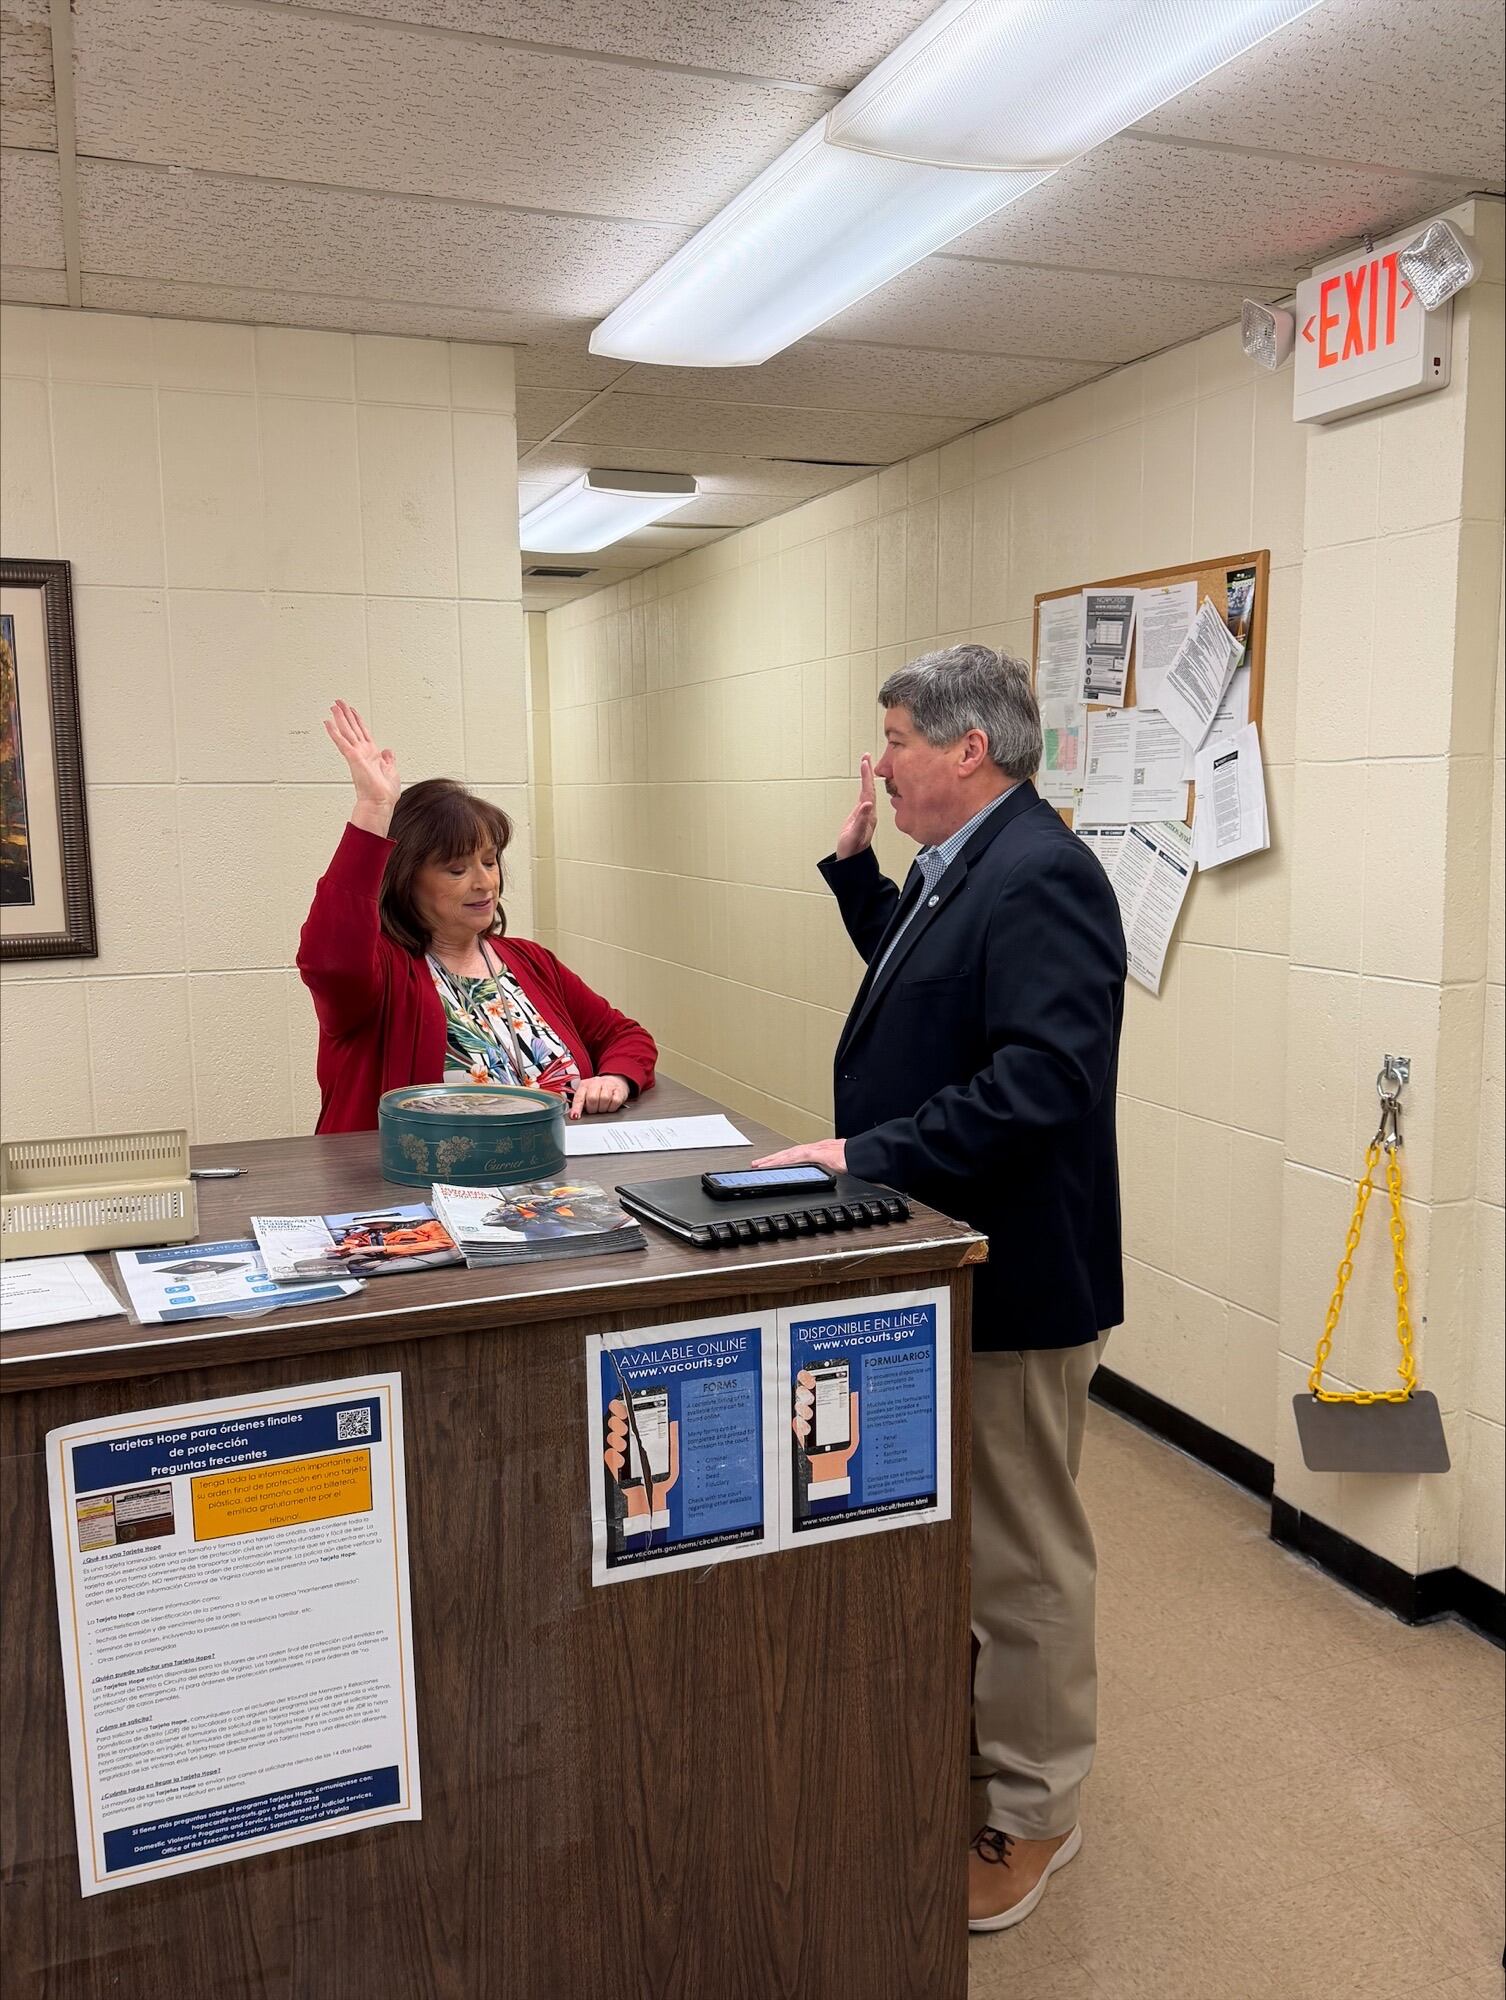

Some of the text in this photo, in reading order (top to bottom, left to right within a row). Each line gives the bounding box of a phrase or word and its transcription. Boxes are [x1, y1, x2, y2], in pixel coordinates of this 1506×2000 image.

[1318, 252, 1400, 368] EXIT
[484, 1158, 524, 1171] Currier
[799, 1312, 928, 1339] DISPONIBLE EN LÍNEA
[813, 1330, 914, 1349] www.vacourts.gov
[619, 1337, 746, 1366] AVAILABLE ONLINE
[864, 1350, 930, 1366] FORMULARIOS
[628, 1355, 738, 1378] www.vacourts.gov
[703, 1378, 737, 1392] FORMS
[109, 1412, 302, 1451] Tarjetas Hope para órdenes finales
[168, 1437, 248, 1457] de protección
[150, 1450, 267, 1479] Preguntas frecuentes
[199, 1479, 224, 1488] Tenga
[226, 1475, 246, 1483] toda
[258, 1465, 305, 1478] información
[307, 1456, 350, 1470] importante
[352, 1455, 363, 1463] de
[196, 1493, 206, 1502] su
[207, 1489, 232, 1498] orden
[233, 1484, 251, 1494] final
[265, 1475, 310, 1489] protección
[311, 1471, 322, 1480] en
[323, 1470, 340, 1478] una
[341, 1463, 367, 1474] tarjeta
[161, 1846, 181, 1854] Office
[203, 1833, 234, 1844] Executive
[270, 1818, 298, 1828] Supreme
[299, 1813, 317, 1821] Court
[326, 1805, 349, 1814] Virginia
